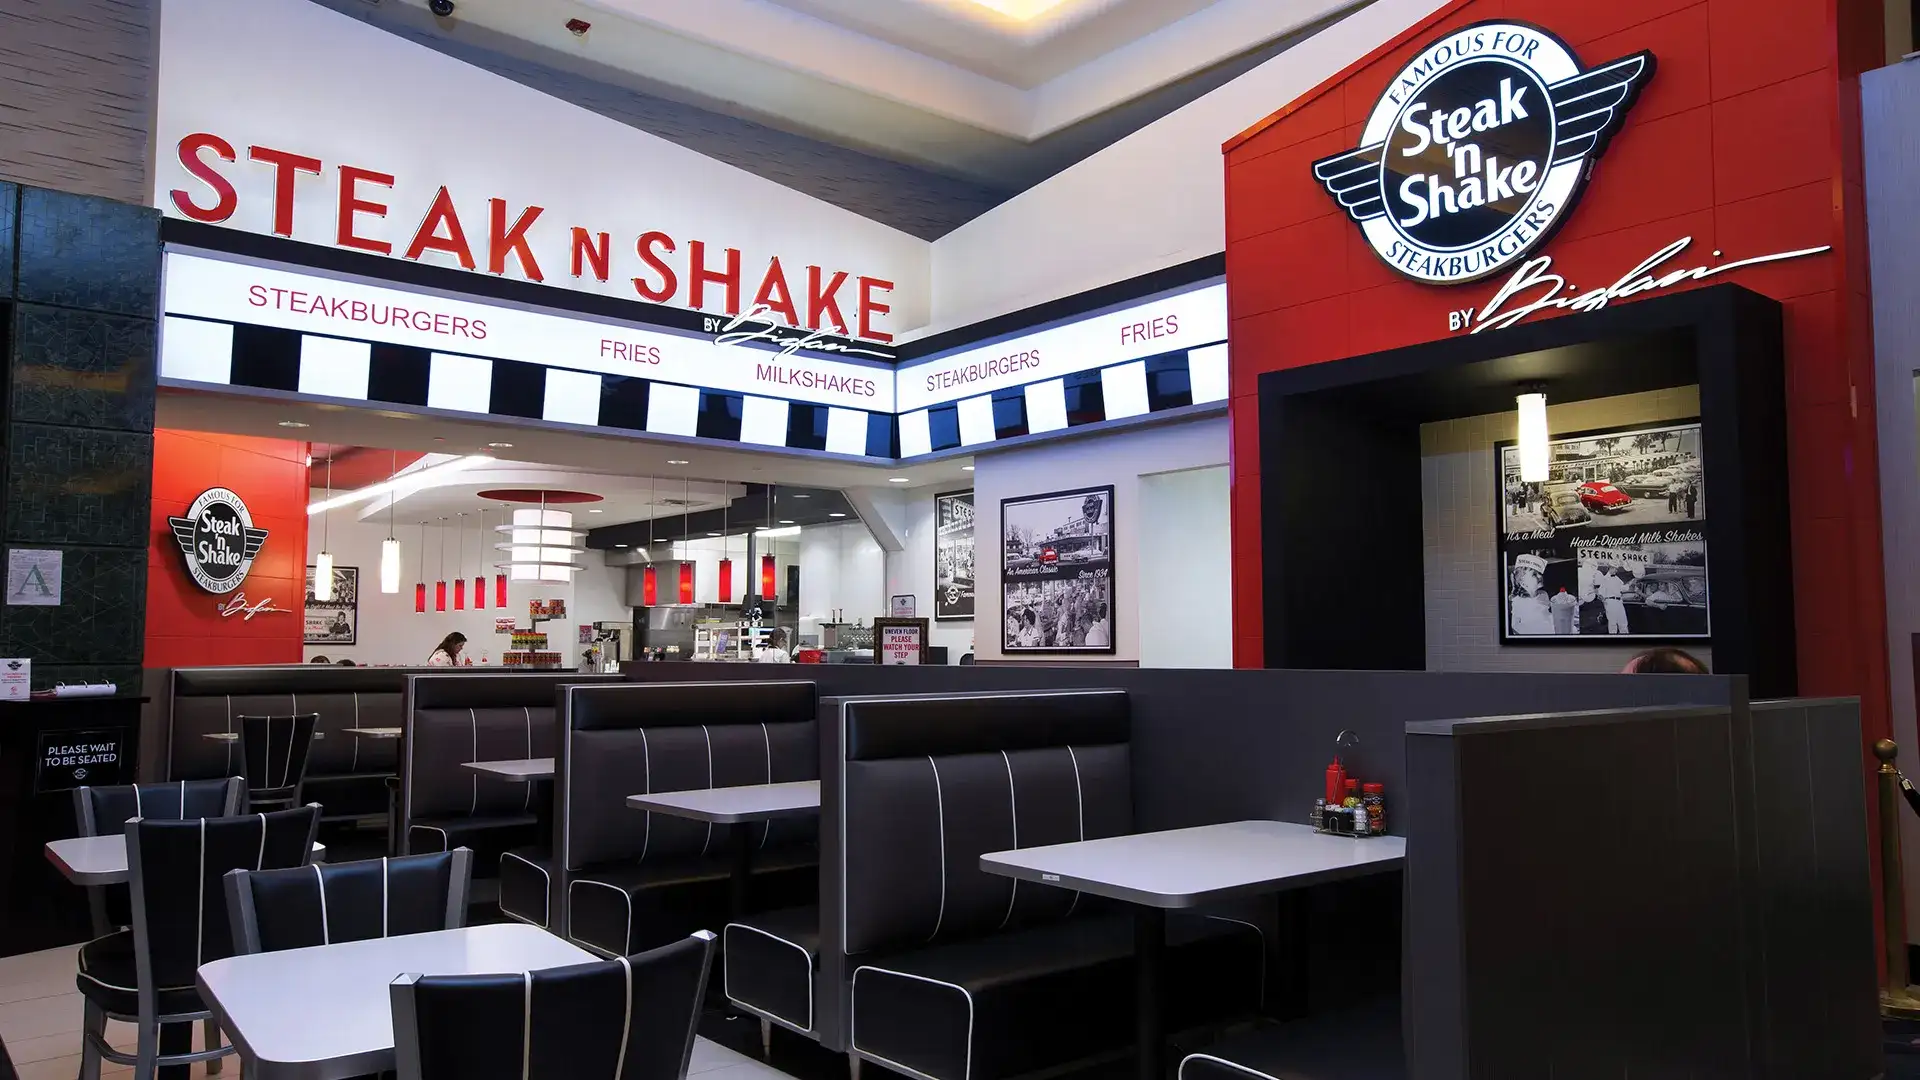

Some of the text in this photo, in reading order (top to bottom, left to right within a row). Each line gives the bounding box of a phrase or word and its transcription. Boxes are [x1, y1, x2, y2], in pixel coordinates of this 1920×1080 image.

[1388, 31, 1540, 106] FAMOUS FOR
[1400, 77, 1529, 157] Steak
[1446, 141, 1481, 179] 'n
[1398, 157, 1538, 228] Shake
[169, 132, 895, 345] STEAK N SHAKE
[1385, 199, 1556, 278] STEAKBURGERS
[248, 284, 488, 341] STEAKBURGERS
[703, 316, 722, 333] BY
[1448, 307, 1475, 332] BY
[1120, 314, 1180, 346] FRIES
[599, 338, 662, 367] FRIES
[755, 363, 876, 397] MILKSHAKES
[926, 348, 1041, 392] STEAKBURGERS
[198, 490, 245, 514] FAMOUS FOR
[201, 509, 241, 536] Steak
[1530, 528, 1556, 540] Meal
[1637, 531, 1662, 544] Milk
[1663, 529, 1704, 543] Shakes
[198, 540, 241, 566] Shake
[1580, 549, 1614, 560] STEAK
[1621, 552, 1648, 563] SHAKE
[193, 566, 245, 592] STEAKBURGERS
[1014, 567, 1039, 576] American
[1039, 564, 1059, 574] Classic
[1078, 570, 1094, 579] Since
[883, 643, 920, 651] WATCH YOUR
[890, 635, 912, 643] PLEASE
[893, 651, 909, 659] STEP
[45, 753, 117, 767] TO BE SEATED
[47, 742, 116, 756] PLEASE WAIT
